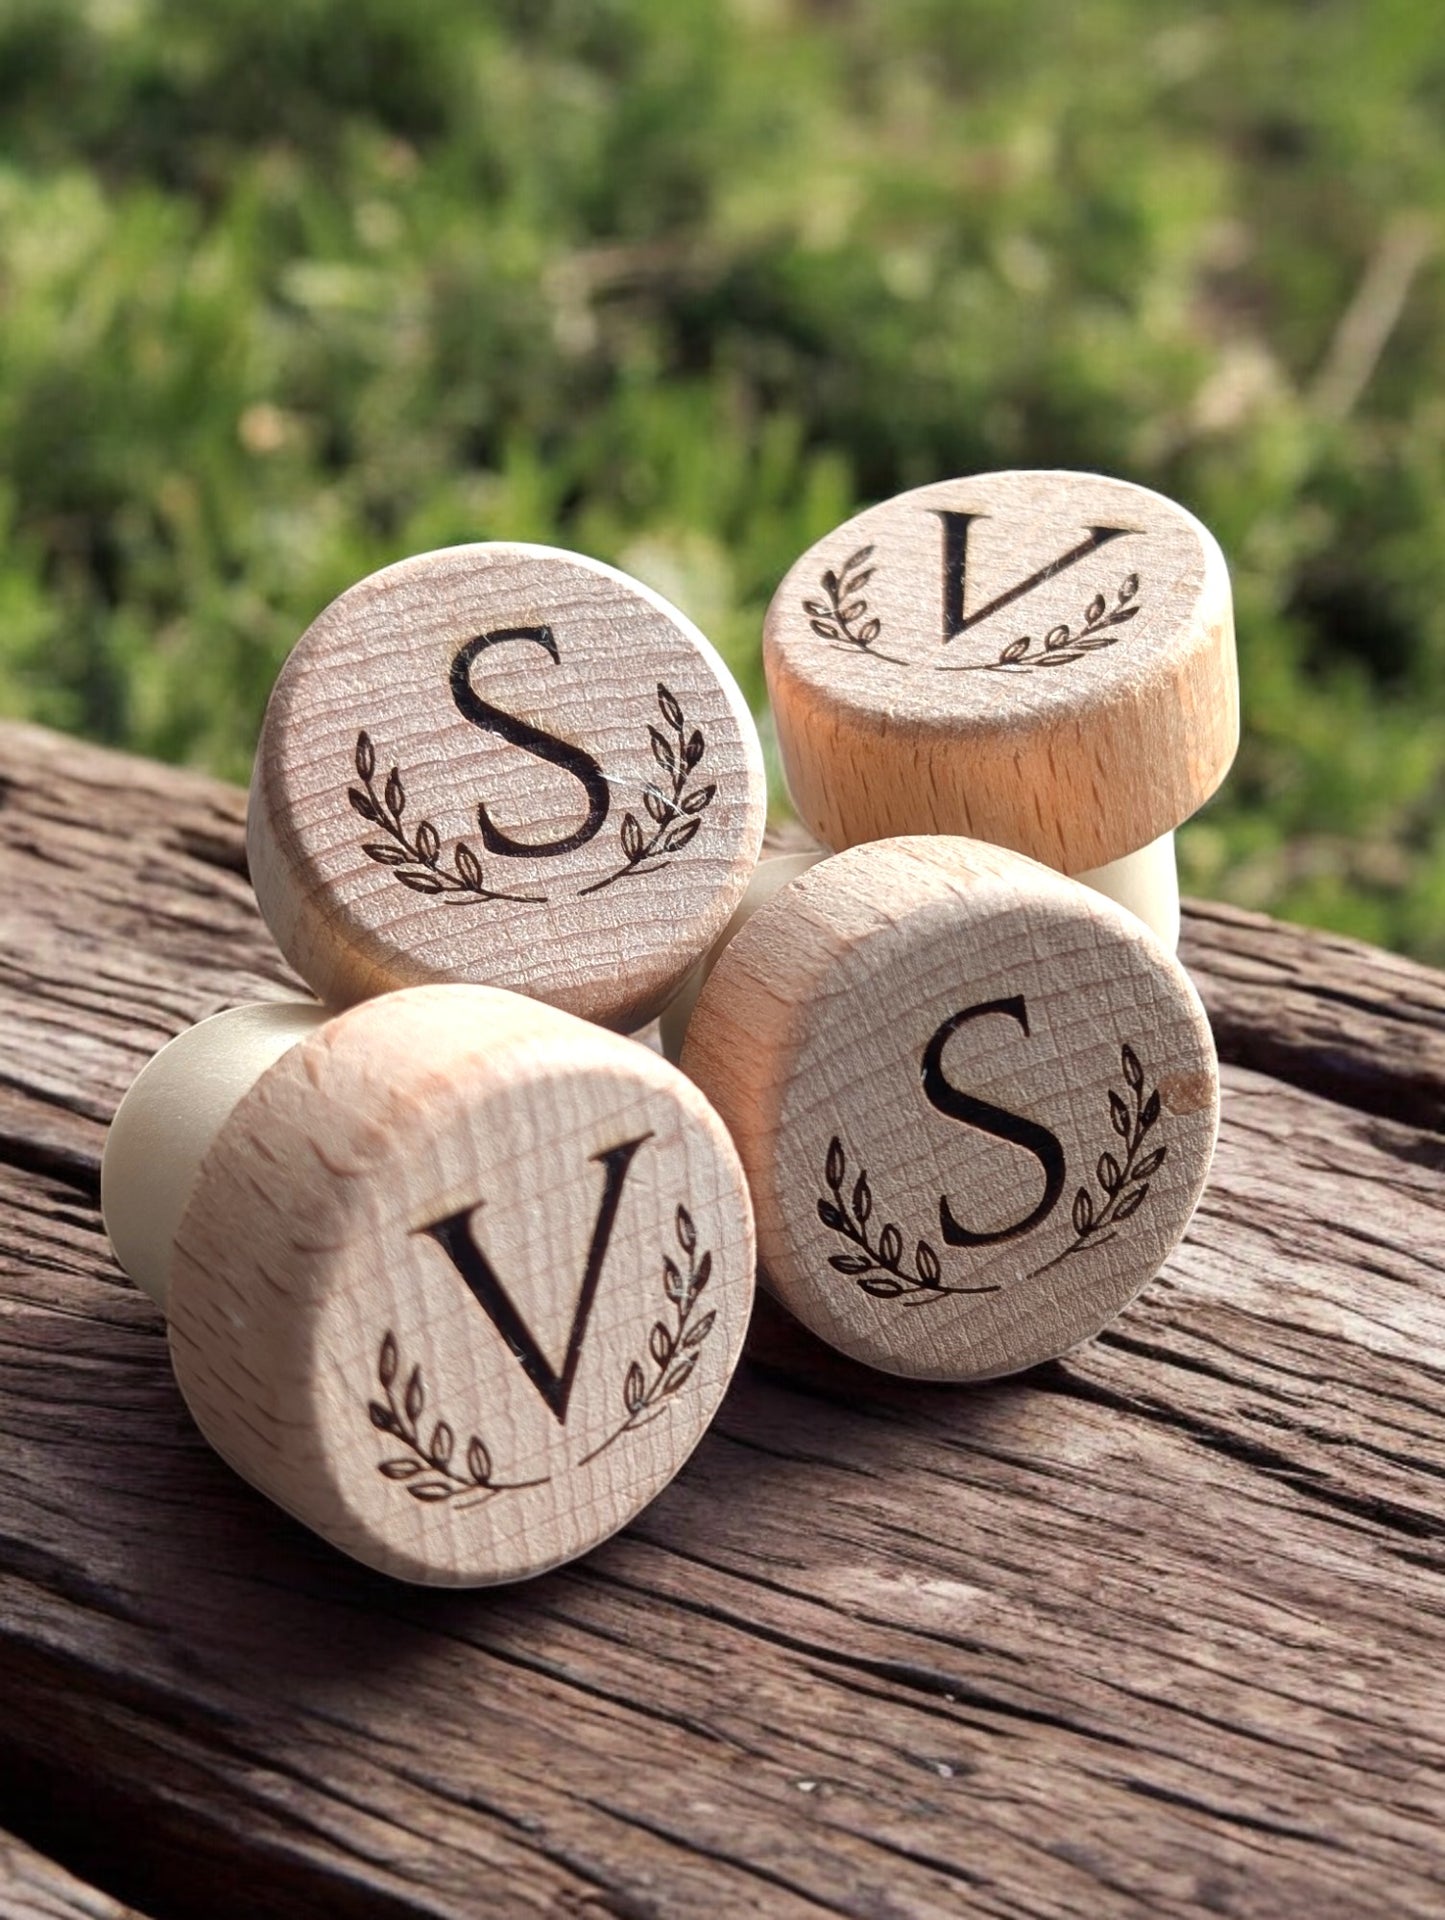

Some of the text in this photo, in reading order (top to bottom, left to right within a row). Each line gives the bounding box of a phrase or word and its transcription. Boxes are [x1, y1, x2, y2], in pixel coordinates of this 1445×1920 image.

[930, 509, 1146, 642] V
[448, 624, 610, 859] S
[920, 993, 1067, 1249] S
[408, 1131, 656, 1426] V
